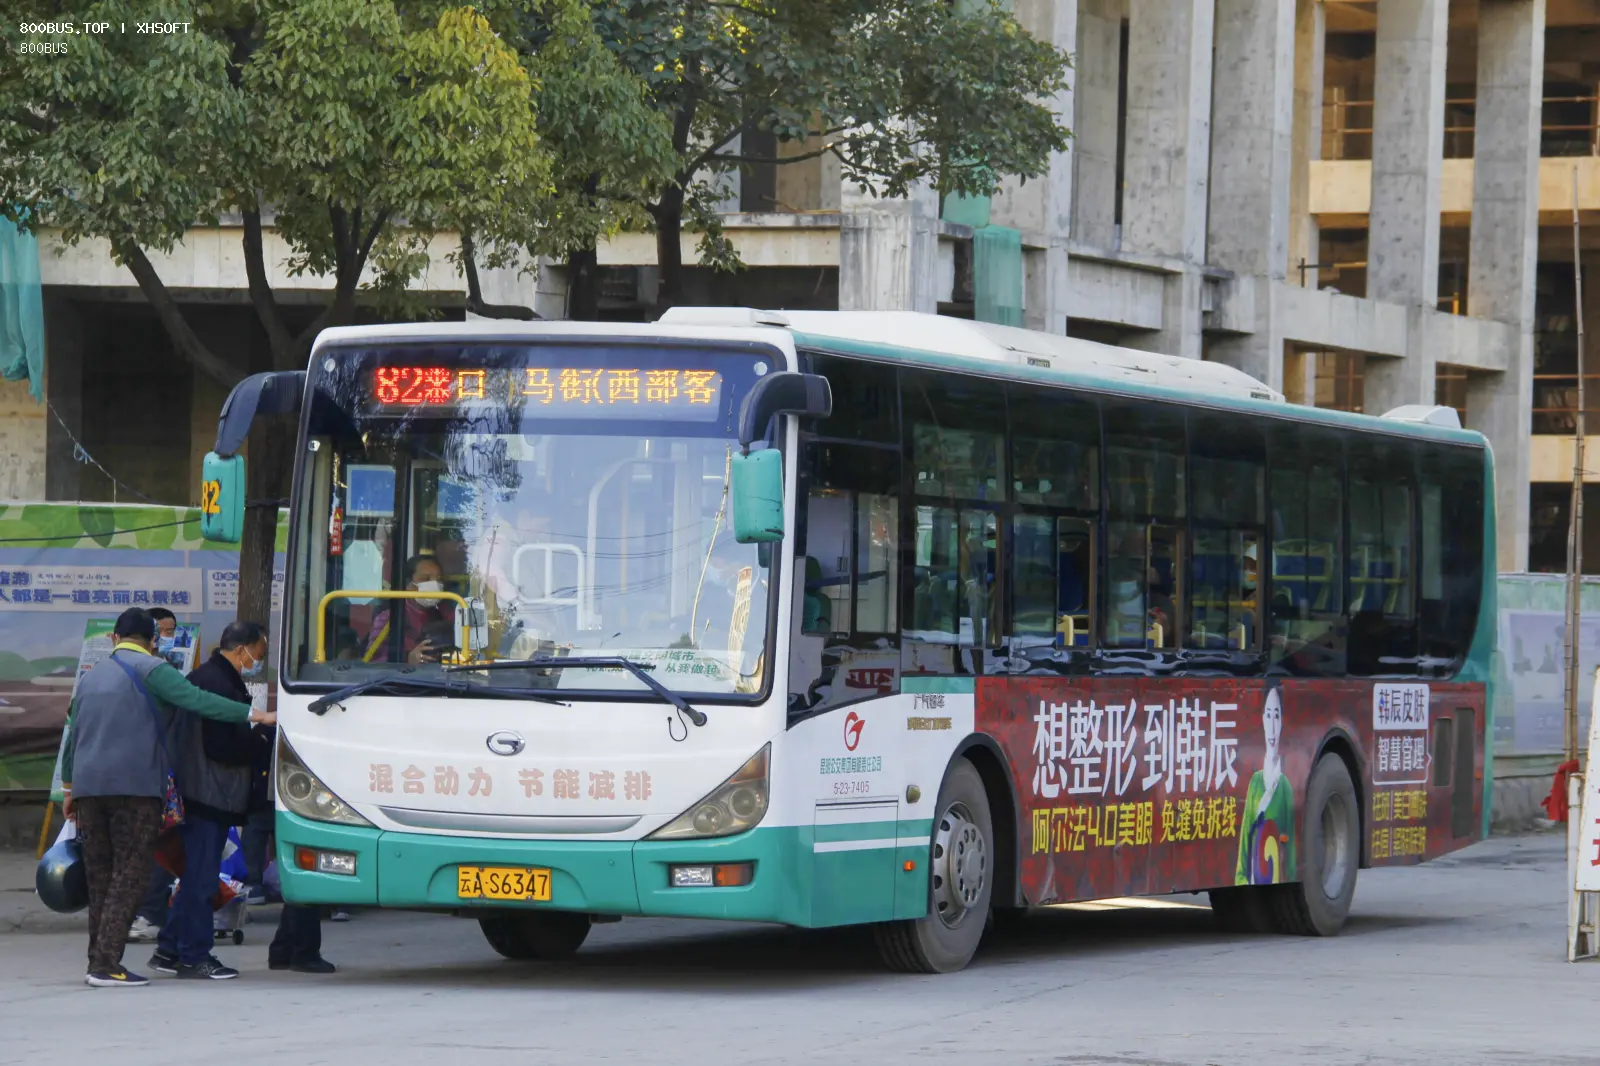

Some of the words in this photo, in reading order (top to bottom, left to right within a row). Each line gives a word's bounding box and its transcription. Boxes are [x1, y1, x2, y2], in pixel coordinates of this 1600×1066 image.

[202, 480, 220, 514] 82
[369, 764, 493, 797] 混合动力
[518, 768, 653, 800] 节能减排
